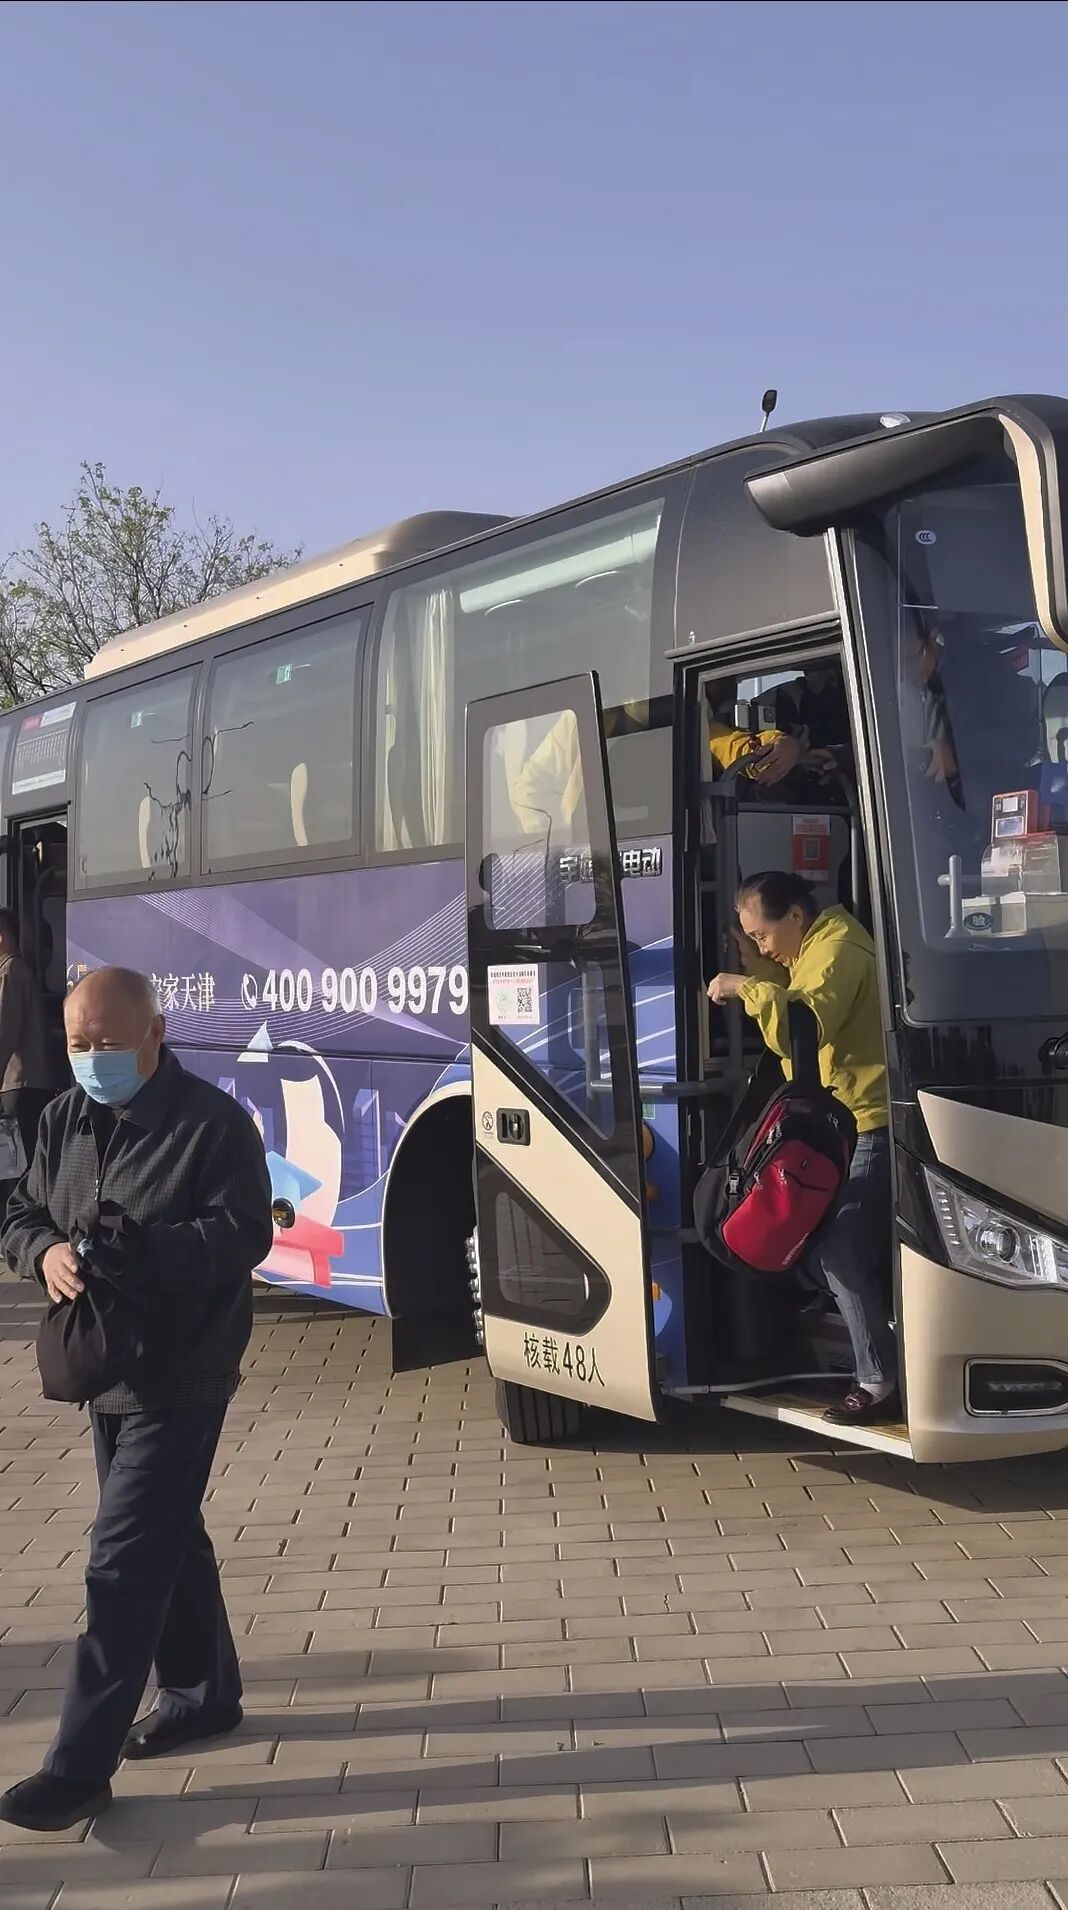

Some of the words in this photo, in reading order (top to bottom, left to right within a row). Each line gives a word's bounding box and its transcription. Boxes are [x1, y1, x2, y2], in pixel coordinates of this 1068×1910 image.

[263, 968, 312, 1012] 400
[322, 967, 378, 1013] 900
[388, 965, 469, 1015] 9979
[524, 1332, 605, 1387] 核载48人
